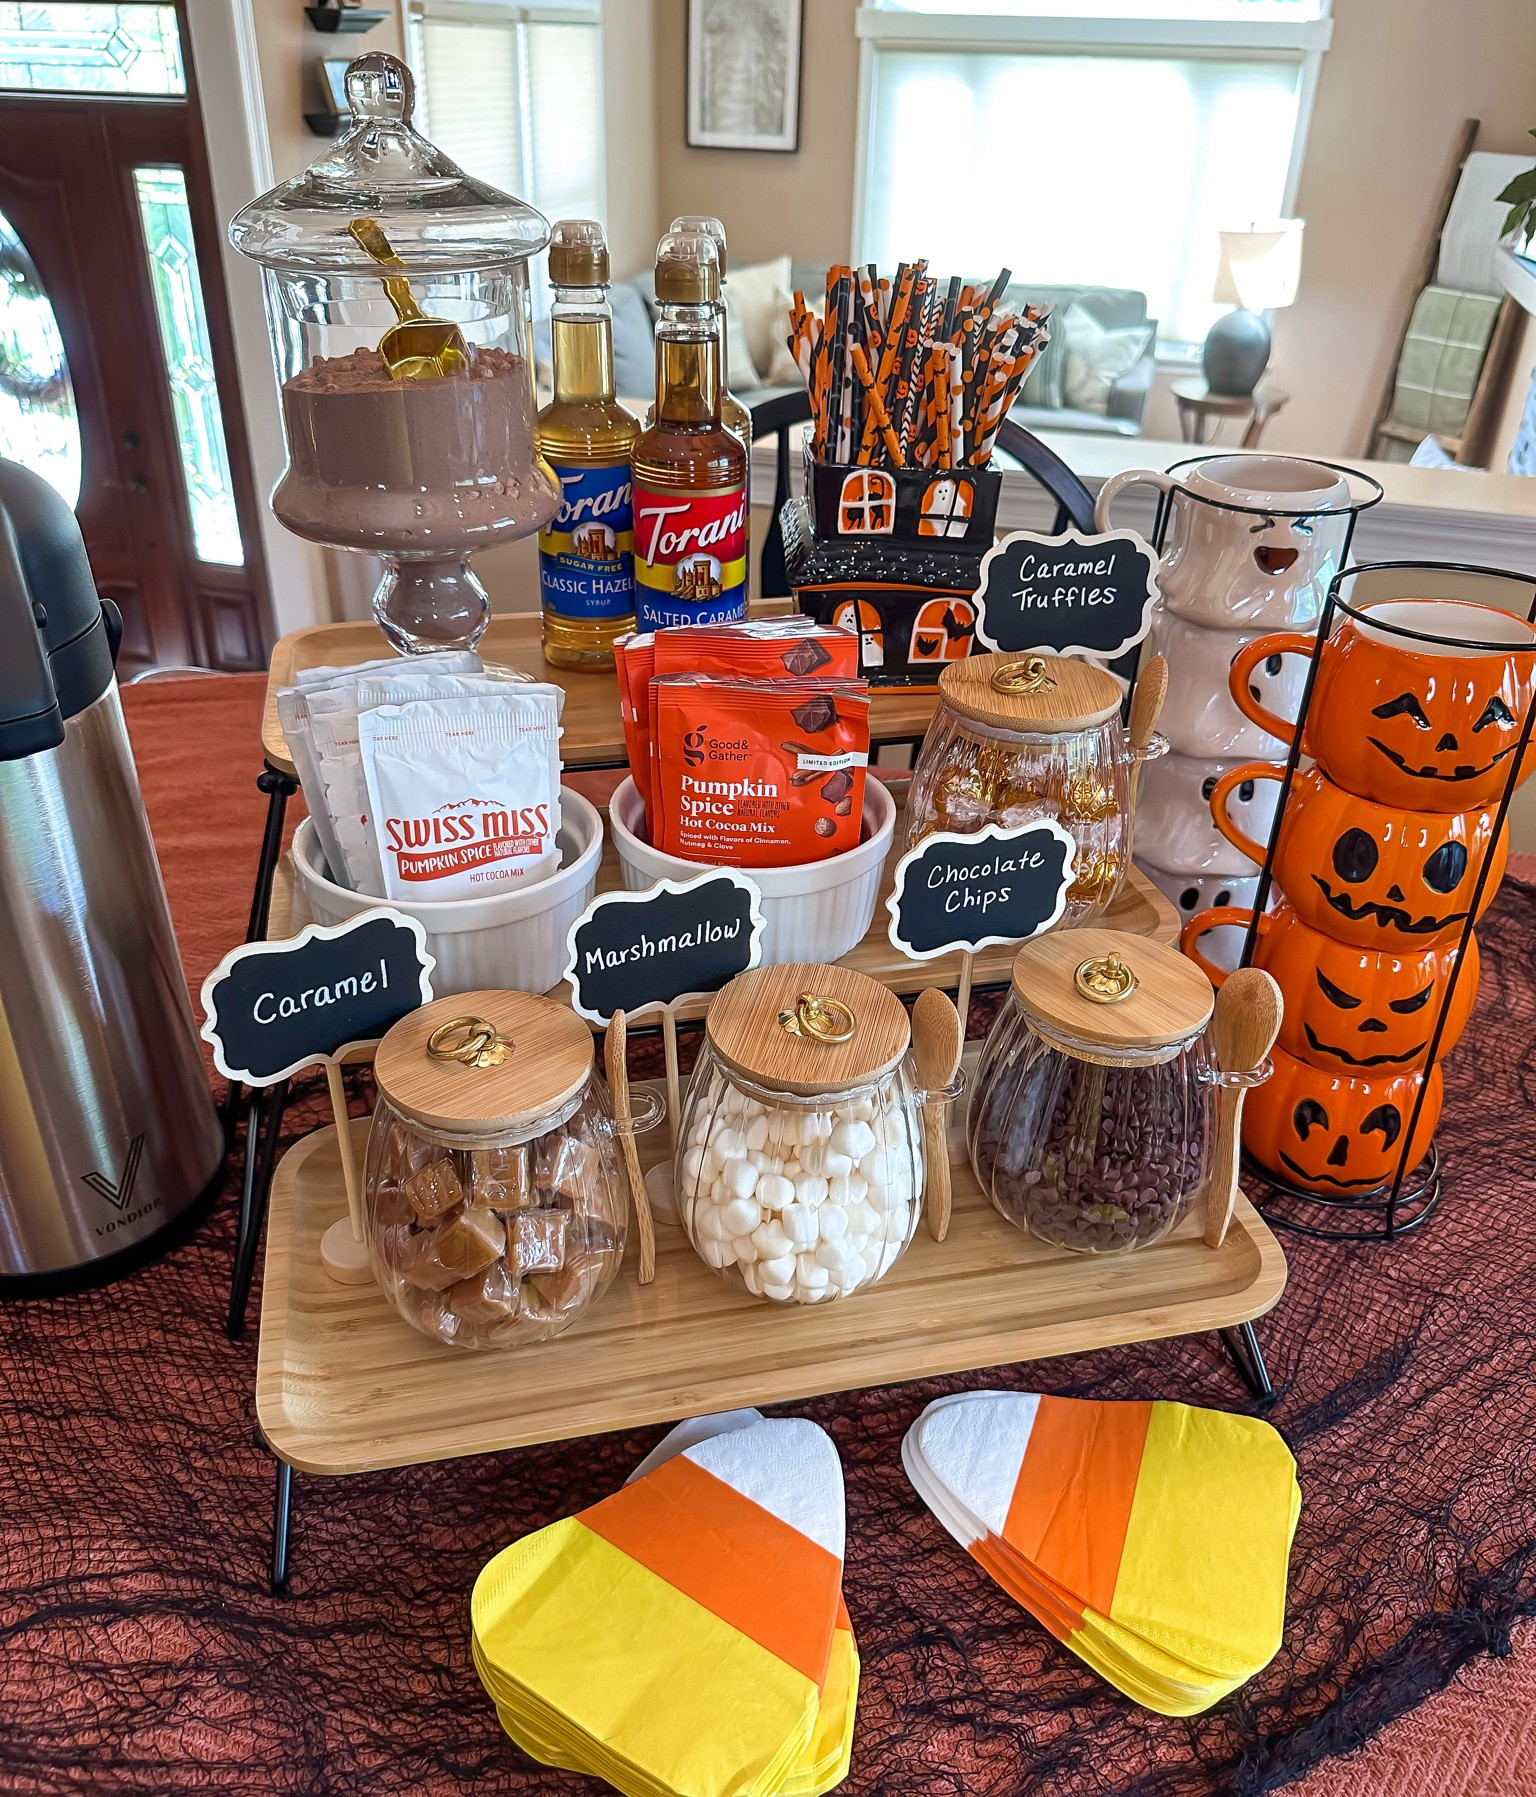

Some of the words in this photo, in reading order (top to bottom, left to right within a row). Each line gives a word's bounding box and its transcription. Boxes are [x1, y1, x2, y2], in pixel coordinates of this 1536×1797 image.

[639, 493, 746, 568] Torani
[560, 556, 595, 572] SUGAR
[597, 563, 623, 573] FREE
[1019, 553, 1117, 582] Caramel
[542, 570, 588, 594] CLASSIC
[1011, 585, 1118, 611] Truffles
[643, 604, 691, 626] SALTED
[708, 750, 748, 762] Gather
[829, 757, 851, 767] EDITION
[680, 774, 778, 801] Pumpkin
[680, 795, 735, 817] Spice
[775, 801, 790, 811] OTHER
[386, 814, 475, 852] SWISS
[680, 815, 703, 828] Hot
[705, 818, 747, 832] Cocoa
[749, 822, 776, 833] Mix
[680, 830, 702, 840] Spiced
[703, 833, 718, 841] with
[719, 835, 744, 843] Flavors
[753, 837, 791, 845] Cinnamon,
[680, 838, 706, 849] Nutmeg
[713, 842, 734, 850] Clove
[401, 854, 459, 875] PUMPKIN
[460, 844, 493, 865] SPICE
[927, 850, 1045, 888] Chocolate
[469, 872, 485, 883] HOT
[485, 871, 509, 881] COCOA
[510, 867, 525, 878] MIX
[944, 886, 1012, 914] Chips
[585, 917, 741, 975] Marshmallow
[253, 958, 389, 1025] Caramel
